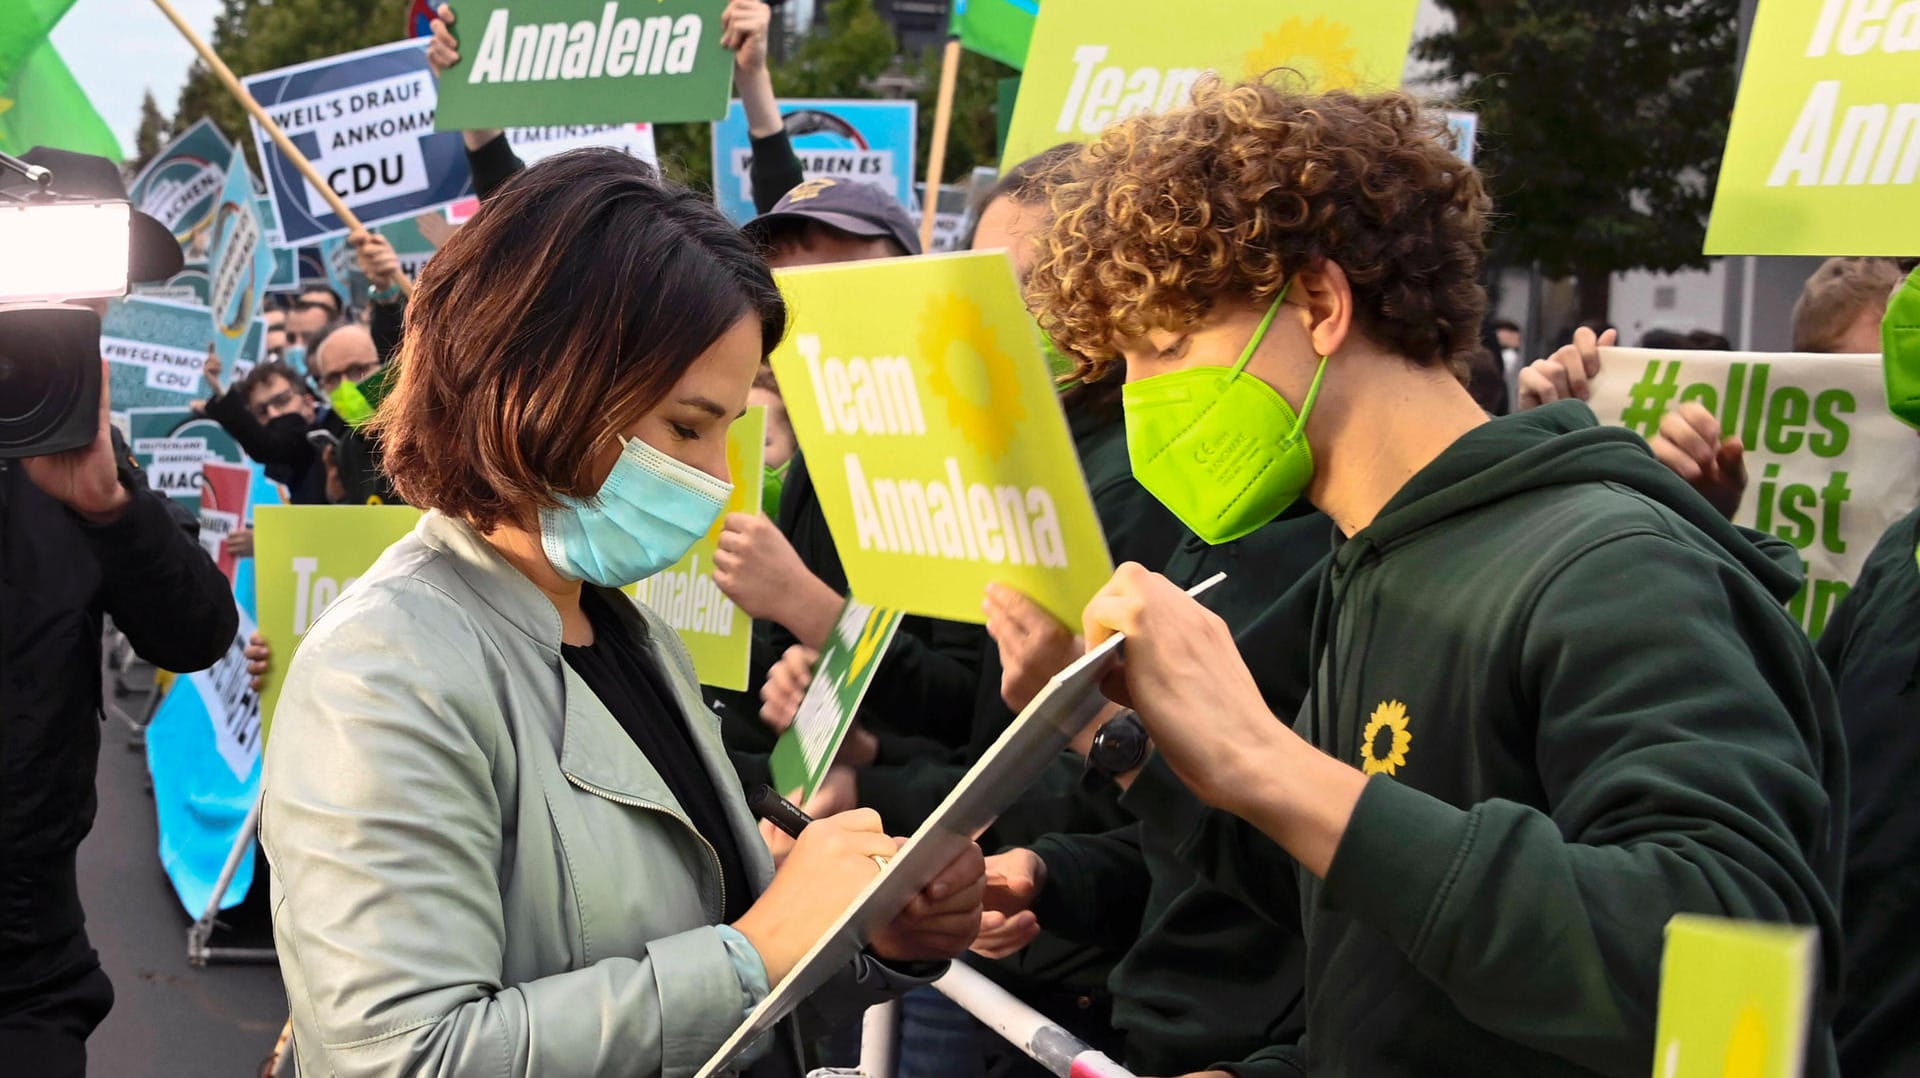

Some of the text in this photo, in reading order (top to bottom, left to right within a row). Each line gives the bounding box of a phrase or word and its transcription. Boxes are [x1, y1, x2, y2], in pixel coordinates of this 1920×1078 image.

[467, 1, 703, 84] Annalena
[271, 81, 423, 131] WEIL'S DRAUF
[327, 154, 404, 199] CDU
[859, 156, 882, 175] ES
[155, 371, 191, 388] CDU
[796, 333, 927, 437] Team
[843, 452, 1069, 568] Annalena
[1755, 463, 1852, 555] ist
[292, 557, 358, 635] Te
